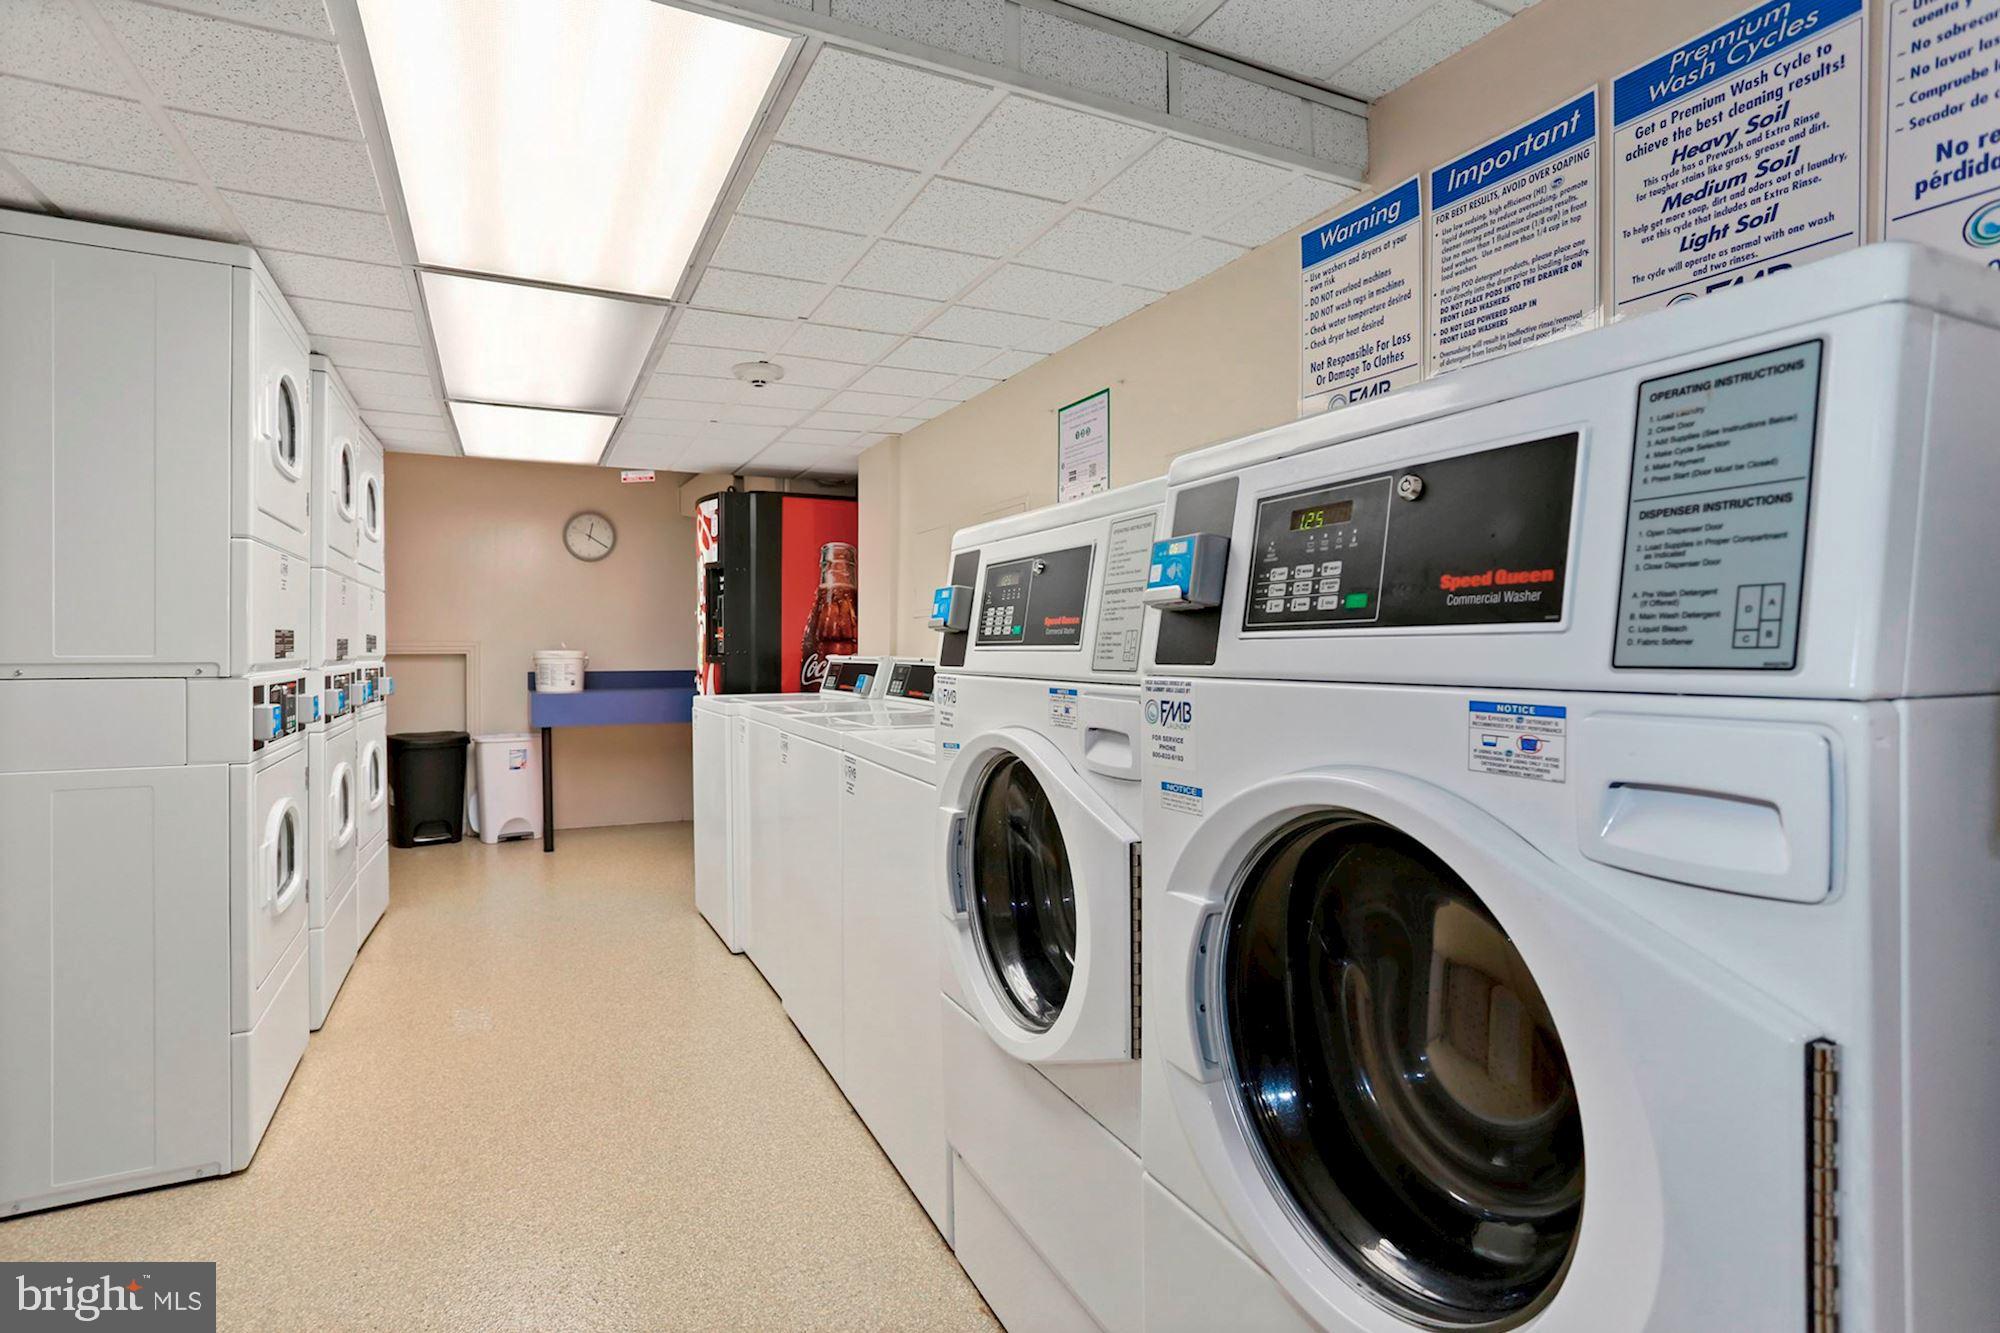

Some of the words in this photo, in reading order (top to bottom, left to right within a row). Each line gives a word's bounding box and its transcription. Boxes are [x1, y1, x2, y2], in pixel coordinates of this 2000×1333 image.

[1912, 1, 1959, 28] cuenta
[1649, 61, 1716, 102] Wash
[1727, 10, 1820, 64] Cycles
[1670, 2, 1791, 74] Premium
[1910, 65, 1930, 80] No
[1935, 46, 1974, 69] lavar
[1979, 36, 2000, 52] las
[1911, 38, 1931, 53] No
[1635, 114, 1656, 139] Get
[1660, 120, 1666, 128] a
[1672, 93, 1725, 124] Premium
[1731, 70, 1768, 96] Wash
[1774, 52, 1811, 78] Cycle
[1817, 44, 1832, 57] to
[1909, 67, 1989, 104] Compruebe
[1626, 137, 1668, 161] achieve
[1673, 127, 1692, 142] the
[1697, 111, 1723, 132] best
[1729, 87, 1783, 117] cleaning
[1789, 55, 1844, 91] results!
[1909, 103, 1964, 130] Secador
[1971, 91, 1988, 108] de
[1448, 109, 1580, 192] Important
[1644, 177, 1658, 187] This
[1661, 168, 1679, 181] cycle
[1682, 162, 1695, 172] has
[1706, 141, 1743, 163] Prewash
[1746, 133, 1762, 146] and
[1766, 124, 1790, 139] Extra
[1794, 112, 1819, 127] Rinse
[1671, 128, 1740, 166] Heavy
[1745, 100, 1790, 134] Soil
[1936, 138, 1968, 162] No
[1636, 194, 1646, 202] for
[1650, 180, 1678, 197] tougher
[1682, 171, 1705, 185] stains
[1708, 164, 1722, 174] like
[1726, 154, 1751, 170] grass,
[1755, 140, 1785, 159] grease
[1789, 128, 1806, 143] and
[1809, 121, 1829, 134] dirt.
[1660, 169, 1747, 213] Medium
[1755, 145, 1800, 178] Soil
[1436, 210, 1449, 224] FOR
[1452, 204, 1467, 218] BEST
[1469, 191, 1499, 209] RESULTS,
[1502, 178, 1526, 195] AVOID
[1529, 167, 1549, 183] OVER
[1553, 149, 1589, 173] SOAPING
[1623, 230, 1631, 238] To
[1633, 224, 1648, 235] help
[1651, 219, 1663, 231] get
[1666, 212, 1685, 223] more
[1688, 204, 1709, 217] soap,
[1712, 196, 1726, 206] dirt
[1730, 187, 1745, 200] and
[1748, 180, 1773, 193] odors
[1777, 172, 1791, 183] out
[1795, 165, 1804, 176] of
[1808, 154, 1846, 172] laundry,
[1320, 200, 1402, 250] Warning
[1641, 231, 1655, 244] use
[1657, 228, 1670, 238] this
[1673, 220, 1692, 234] cycle
[1695, 211, 1711, 225] that
[1714, 202, 1747, 218] includes
[1751, 197, 1761, 205] an
[1764, 187, 1789, 200] Extra
[1792, 176, 1821, 190] Rinse.
[1680, 223, 1729, 252] Light
[1735, 203, 1779, 233] Soil
[1310, 273, 1321, 282] Use
[1323, 261, 1346, 276] washers
[1348, 252, 1359, 265] and
[1384, 241, 1390, 250] at
[1393, 234, 1407, 248] your
[1632, 275, 1645, 284] The
[1648, 268, 1665, 281] cycle
[1668, 261, 1682, 272] will
[1685, 253, 1716, 268] operate
[1719, 249, 1728, 257] as
[1731, 235, 1761, 253] normal
[1764, 228, 1784, 242] with
[1788, 224, 1804, 234] one
[1808, 212, 1834, 228] wash
[1692, 265, 1707, 276] and
[1711, 261, 1727, 271] two
[1730, 252, 1758, 265] rinses.
[1310, 280, 1322, 292] own
[1324, 275, 1335, 286] risk
[1310, 296, 1319, 306] DO
[1321, 290, 1333, 302] NOT
[1335, 278, 1361, 297] overload
[1363, 269, 1391, 285] machines
[1310, 311, 1319, 321] DO
[1321, 304, 1333, 317] NOT
[1335, 298, 1351, 311] wash
[1353, 295, 1366, 305] rugs
[1368, 290, 1374, 299] in
[1376, 279, 1405, 295] machines
[1440, 303, 1449, 315] DO
[1451, 297, 1463, 311] NOT
[1465, 295, 1483, 306] PLACE
[1485, 288, 1502, 299] PODS
[1505, 280, 1521, 292] INTO
[1523, 276, 1535, 286] THE
[1538, 265, 1569, 281] DRAWER
[1571, 260, 1582, 269] ON
[1310, 322, 1326, 335] Check
[1329, 317, 1346, 328] water
[1348, 302, 1386, 321] temperature
[1388, 289, 1411, 306] desired
[1440, 312, 1459, 324] FRONT
[1461, 307, 1477, 317] LOAD
[1479, 295, 1510, 310] WASHERS
[1310, 337, 1326, 349] Check
[1328, 333, 1344, 344] dryer
[1346, 326, 1359, 337] heat
[1361, 315, 1384, 332] desired
[1311, 361, 1324, 373] Not
[1327, 344, 1373, 368] Responsible
[1377, 340, 1389, 352] For
[1393, 333, 1410, 347] Loss
[1317, 375, 1325, 386] Or
[1329, 365, 1359, 382] Damage
[1362, 360, 1371, 371] To
[1374, 351, 1404, 368] Clothes
[1649, 381, 1711, 403] OPERATING
[1714, 359, 1805, 388] INSTRUCTIONS
[1639, 505, 1699, 520] DISPENSER
[1703, 492, 1793, 512] INSTRUCTIONS
[1441, 572, 1492, 591] Speed
[1496, 568, 1554, 585] Queen
[1447, 590, 1501, 606] Commercial
[1503, 589, 1542, 603] Washer
[1160, 699, 1192, 726] FMB
[1497, 704, 1536, 714] NOTICE
[1159, 744, 1176, 752] PHONE
[1163, 736, 1184, 744] SERVICE
[1166, 784, 1197, 796] NOTICE
